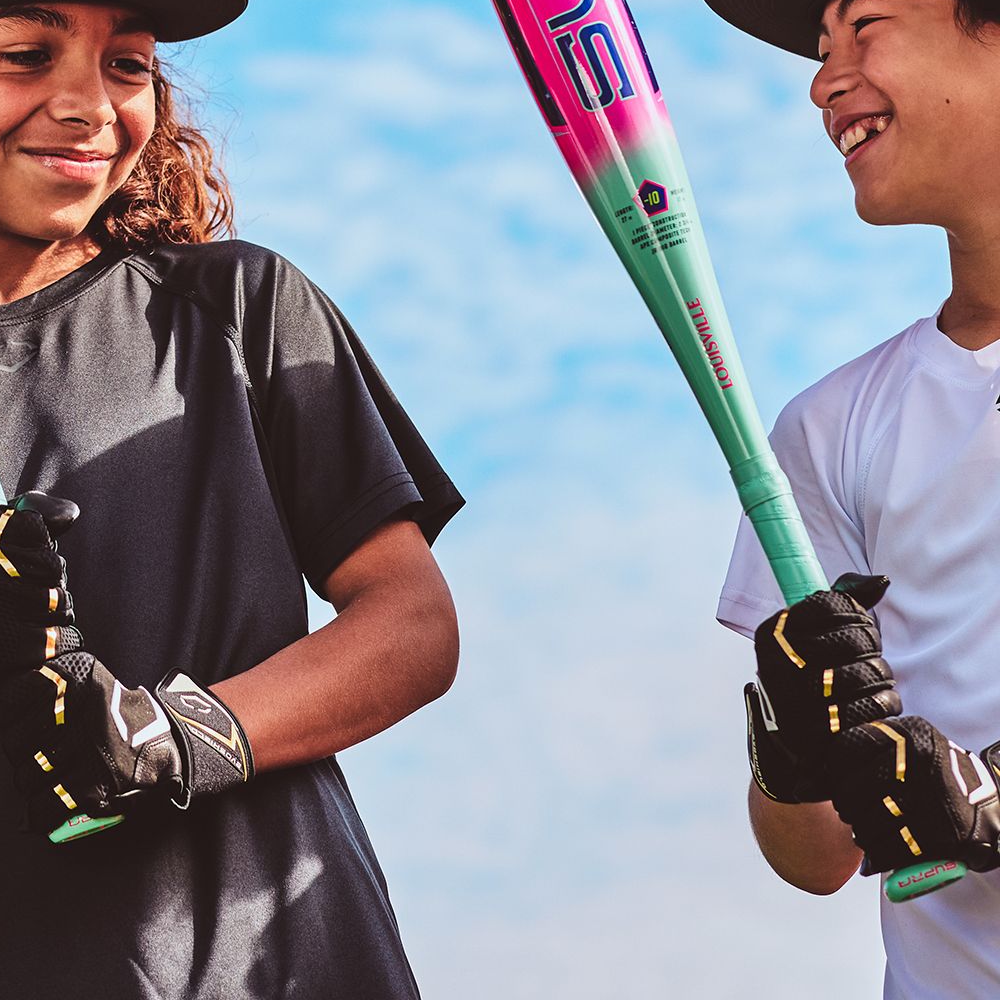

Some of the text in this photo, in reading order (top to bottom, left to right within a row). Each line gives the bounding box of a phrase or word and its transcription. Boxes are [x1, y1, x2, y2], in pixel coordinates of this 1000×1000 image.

[643, 190, 660, 206] -10
[650, 231, 680, 245] CMPOSITE
[686, 297, 734, 391] LOUISVILLE
[897, 860, 958, 889] SUPRA
